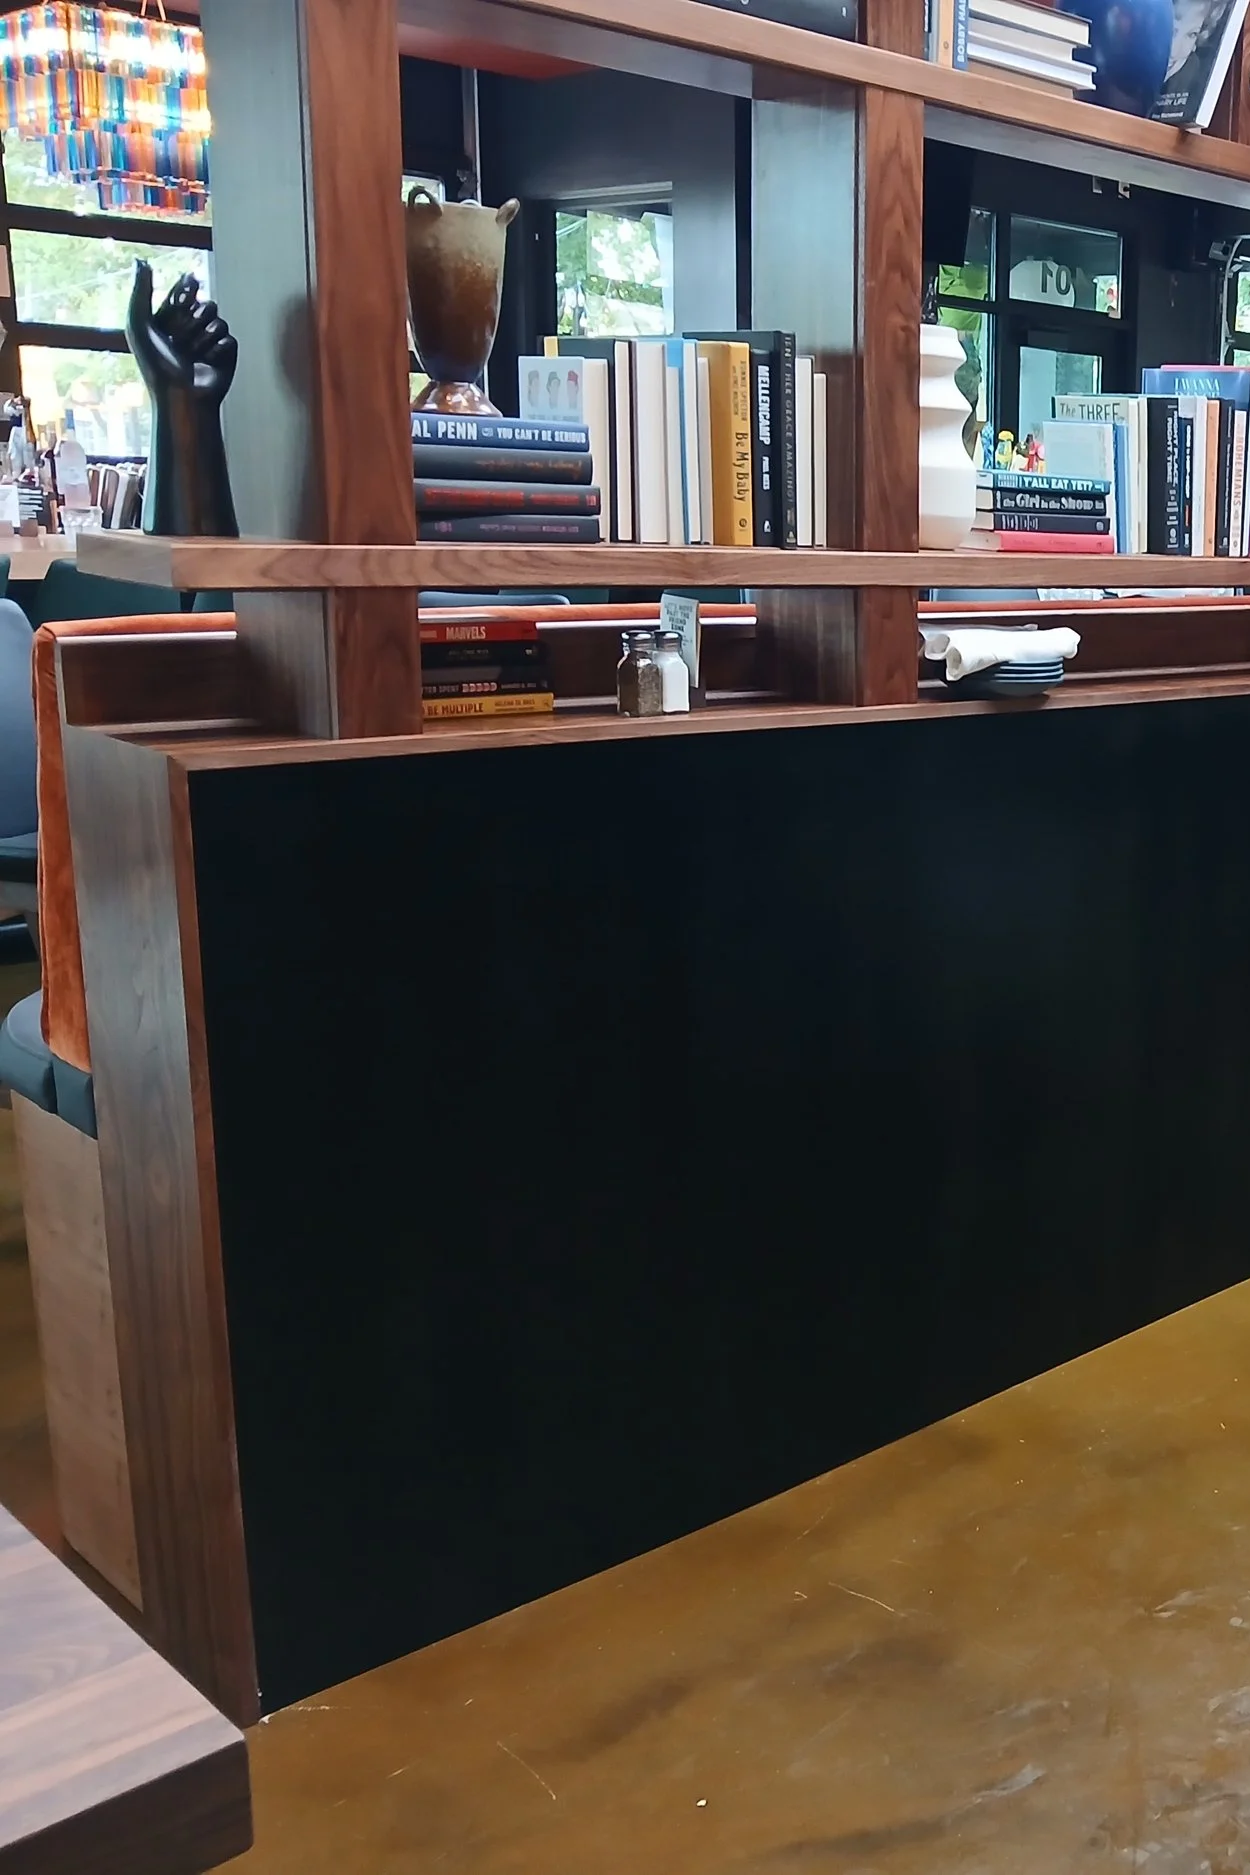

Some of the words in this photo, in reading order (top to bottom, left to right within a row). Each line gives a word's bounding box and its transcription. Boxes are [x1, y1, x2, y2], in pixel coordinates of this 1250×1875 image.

[957, 22, 966, 63] BOBBY
[758, 365, 771, 445] MELLENCAMP
[1059, 402, 1077, 416] The
[412, 420, 431, 438] AL
[437, 421, 477, 440] PENN
[496, 427, 513, 440] YOU
[735, 432, 748, 447] Be
[732, 451, 749, 469] My
[733, 472, 749, 501] Baby
[1051, 479, 1070, 490] EAT
[1071, 480, 1092, 491] YET?
[446, 626, 486, 640] MARVELS
[442, 702, 484, 715] MULTIPLE
